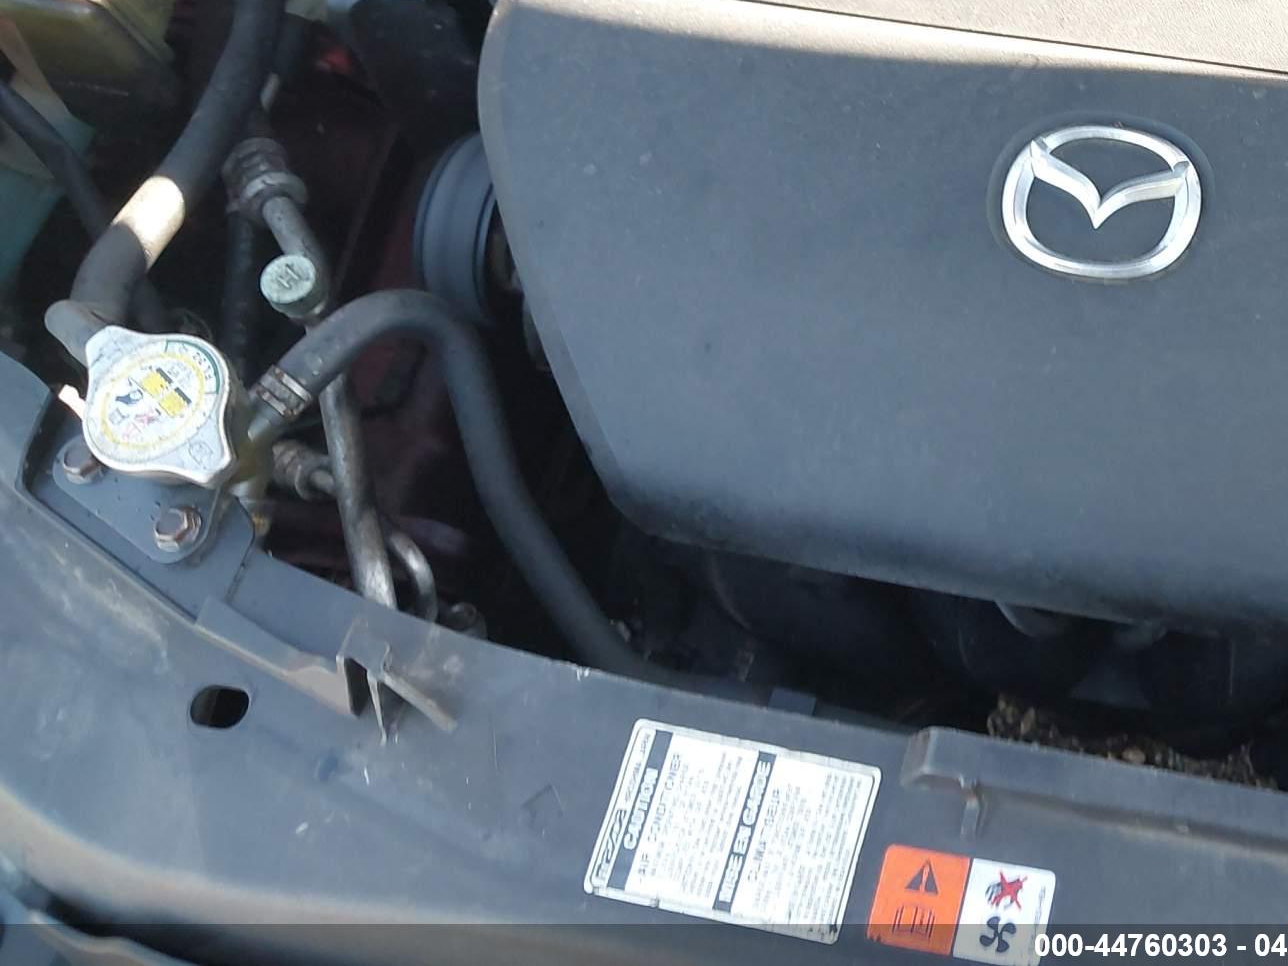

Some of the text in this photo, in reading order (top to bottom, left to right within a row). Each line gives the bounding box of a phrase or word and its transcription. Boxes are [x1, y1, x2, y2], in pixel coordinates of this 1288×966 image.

[621, 767, 659, 850] CAUTION
[717, 854, 743, 902] MISE
[732, 824, 752, 854] EN
